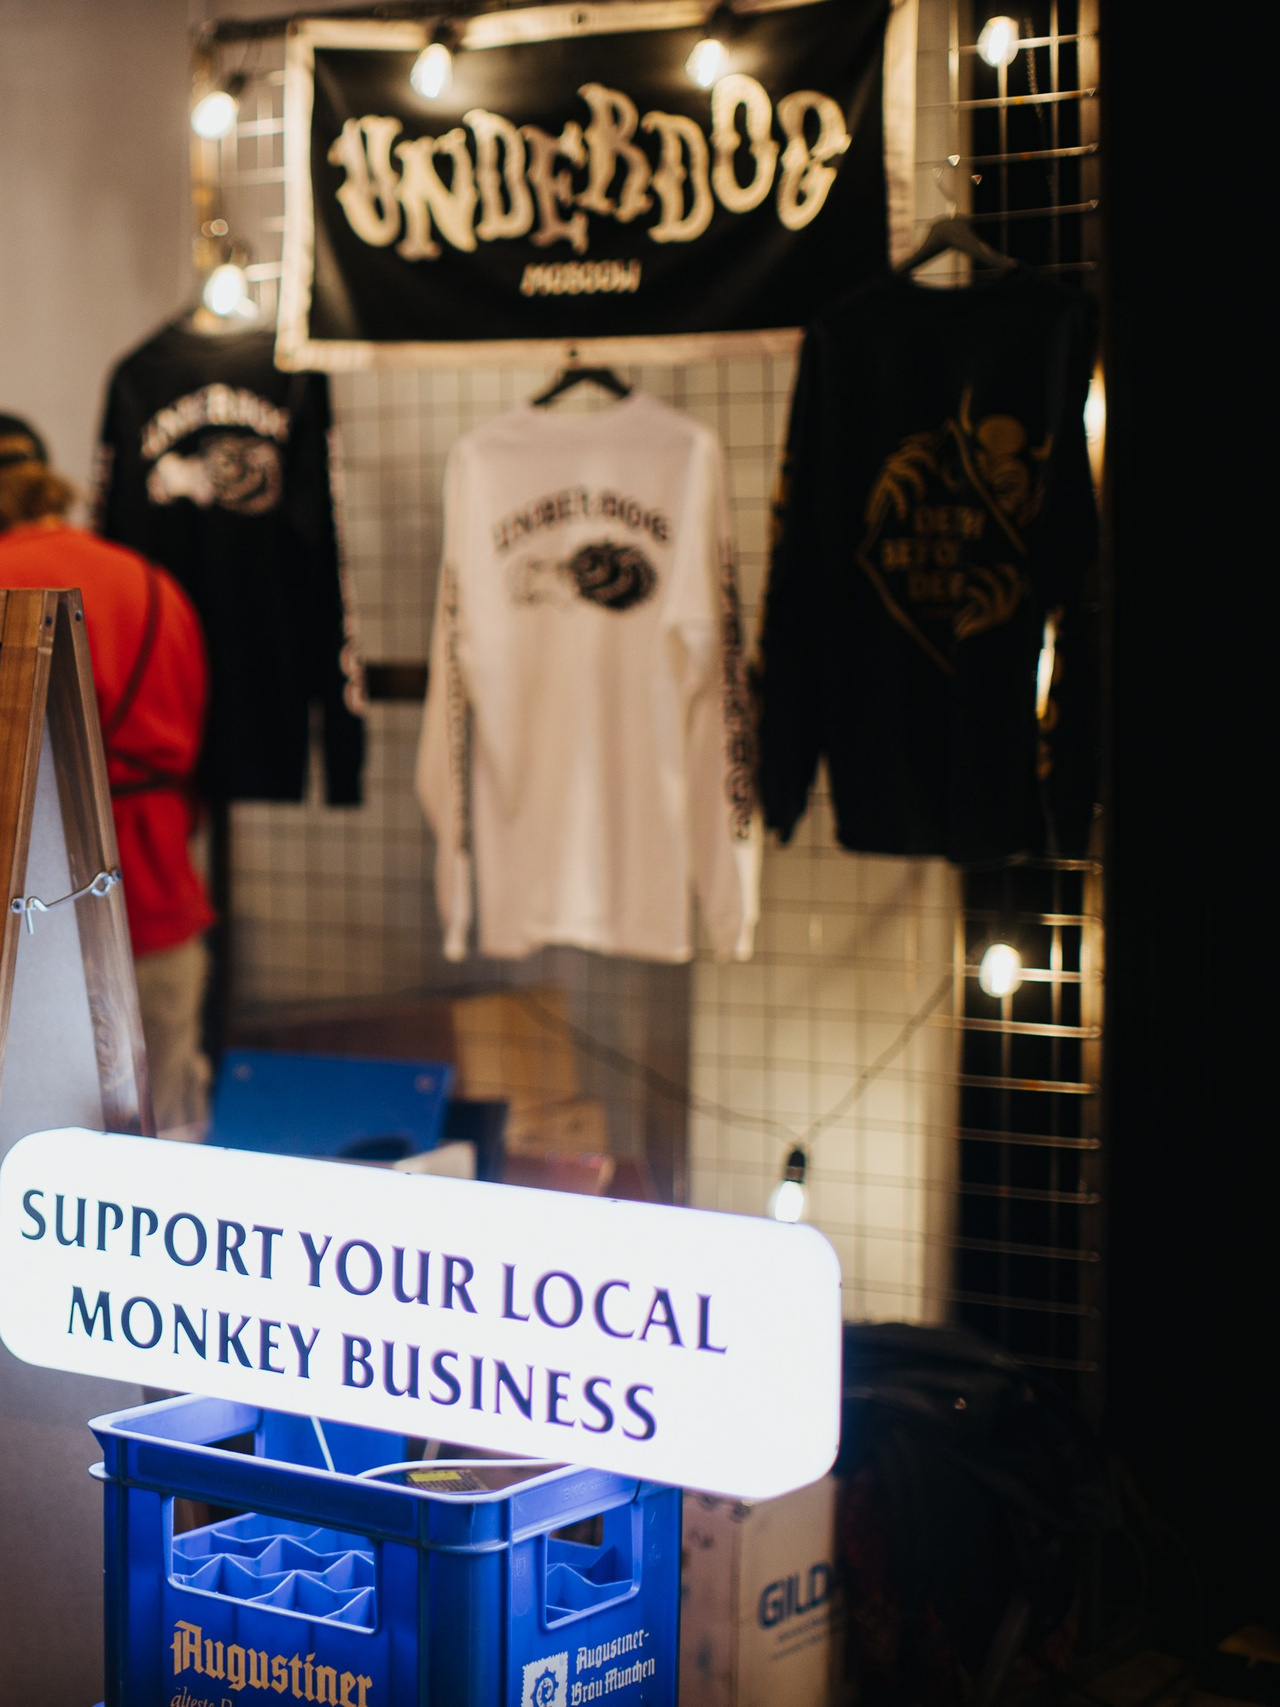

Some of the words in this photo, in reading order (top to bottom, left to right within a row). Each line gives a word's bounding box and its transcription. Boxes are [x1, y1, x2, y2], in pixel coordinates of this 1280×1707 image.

[328, 72, 852, 262] UNDERDOG
[521, 259, 641, 297] MOSCOW
[21, 1189, 284, 1280] SUPPORT
[298, 1230, 478, 1314] YOUR
[500, 1262, 727, 1354] LOCAL
[68, 1285, 320, 1379] MONKEY
[341, 1331, 658, 1442] BUSINESS
[758, 1561, 833, 1629] GILD
[170, 1620, 373, 1707] Augustiner
